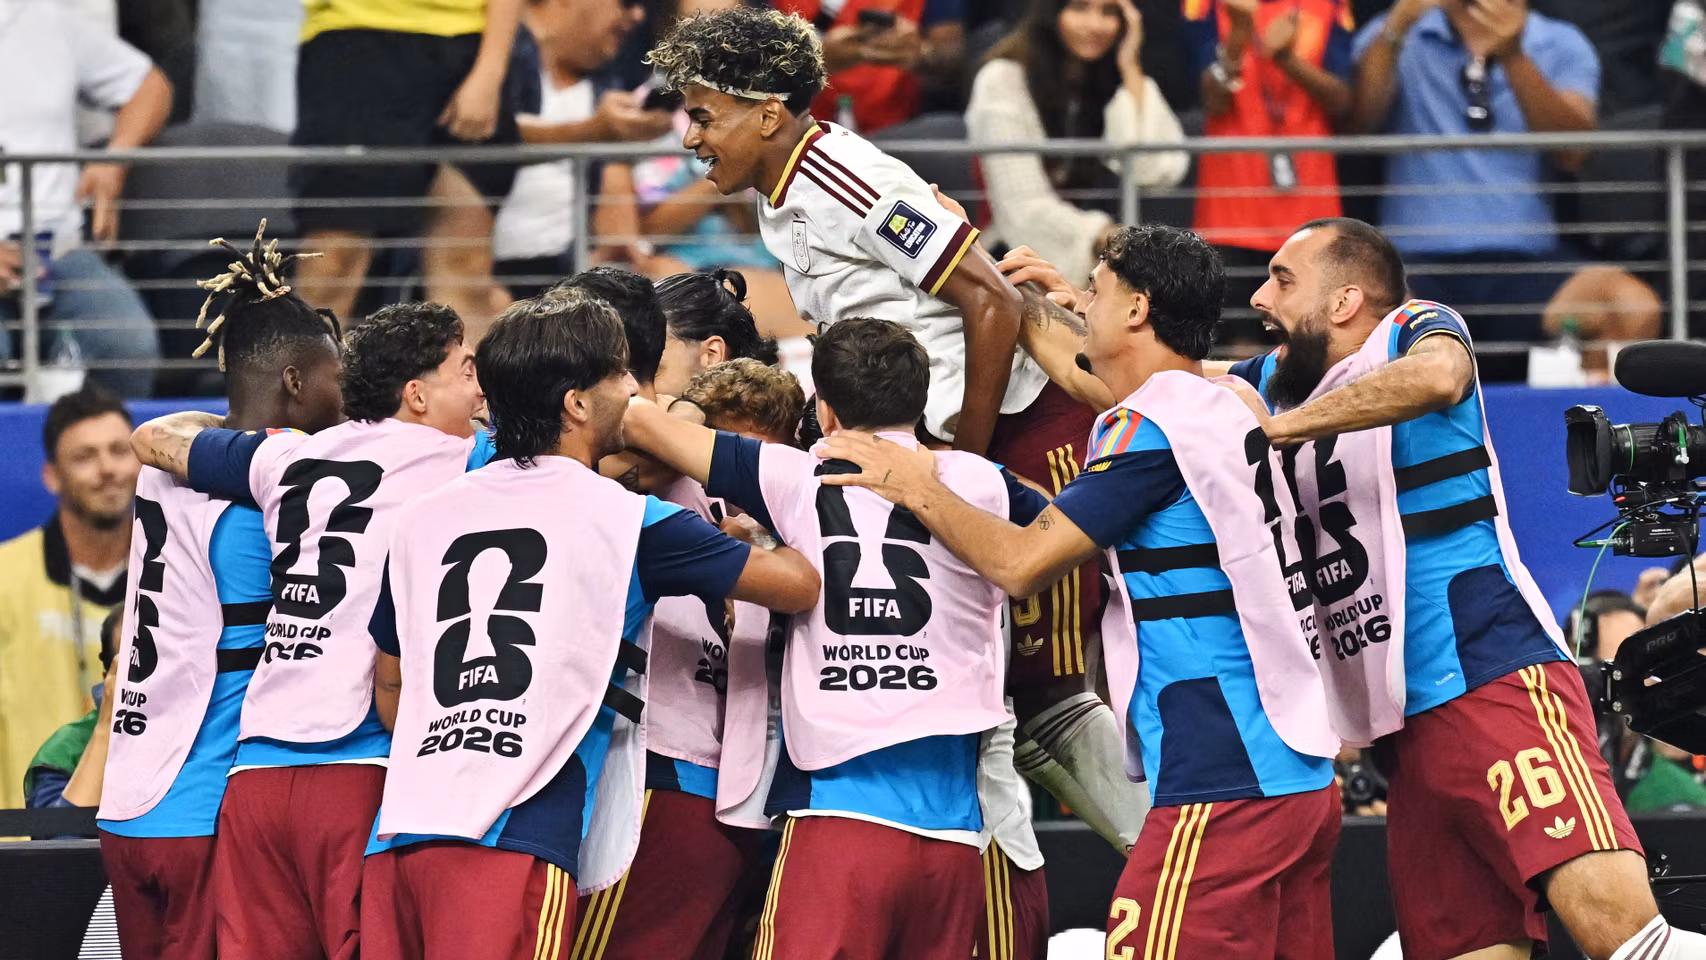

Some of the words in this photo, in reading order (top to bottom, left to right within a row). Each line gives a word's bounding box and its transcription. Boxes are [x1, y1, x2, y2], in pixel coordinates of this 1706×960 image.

[904, 221, 926, 249] EDUCATION
[1316, 558, 1353, 588] FIFA
[281, 583, 320, 604] FIFA
[1355, 594, 1383, 617] UP
[848, 597, 901, 619] FIFA
[822, 644, 891, 661] WORLD
[895, 644, 930, 662] CUP
[458, 664, 499, 690] FIFA
[819, 664, 938, 691] 2026
[428, 708, 482, 733] WORLD
[485, 708, 527, 728] CUP
[417, 726, 523, 758] 2026
[1487, 747, 1567, 832] 26
[1106, 896, 1141, 960] 2
